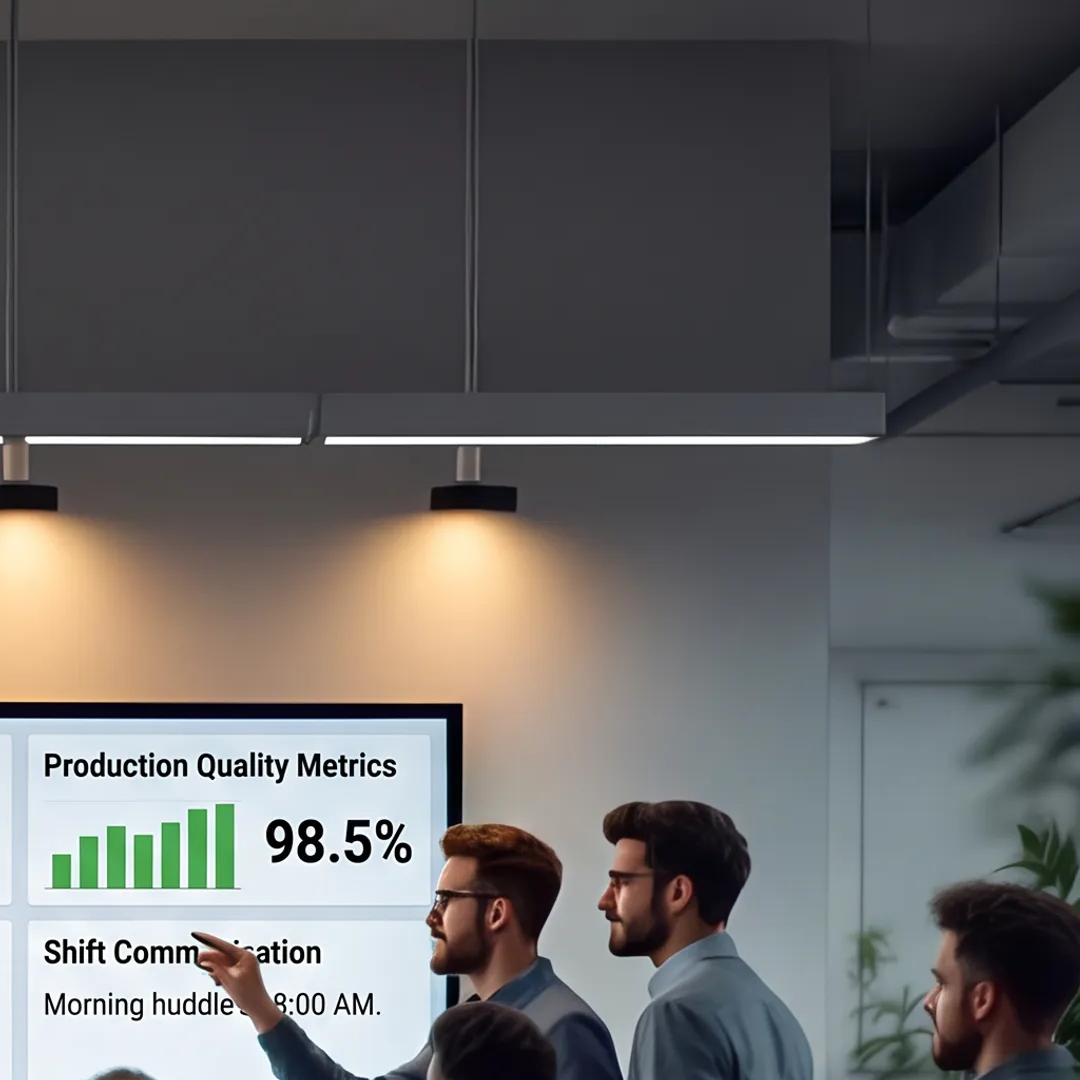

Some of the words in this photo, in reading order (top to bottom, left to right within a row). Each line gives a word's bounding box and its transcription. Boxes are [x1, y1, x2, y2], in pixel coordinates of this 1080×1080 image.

[44, 752, 188, 777] Production
[197, 752, 289, 784] Quality
[298, 752, 397, 777] Metrics
[265, 819, 412, 863] 98.5%
[44, 939, 106, 964] Shift
[114, 939, 321, 964] Commation
[44, 992, 144, 1021] Morning
[152, 992, 234, 1015] huddle
[274, 992, 325, 1015] 8:00
[333, 993, 381, 1015] AM.
